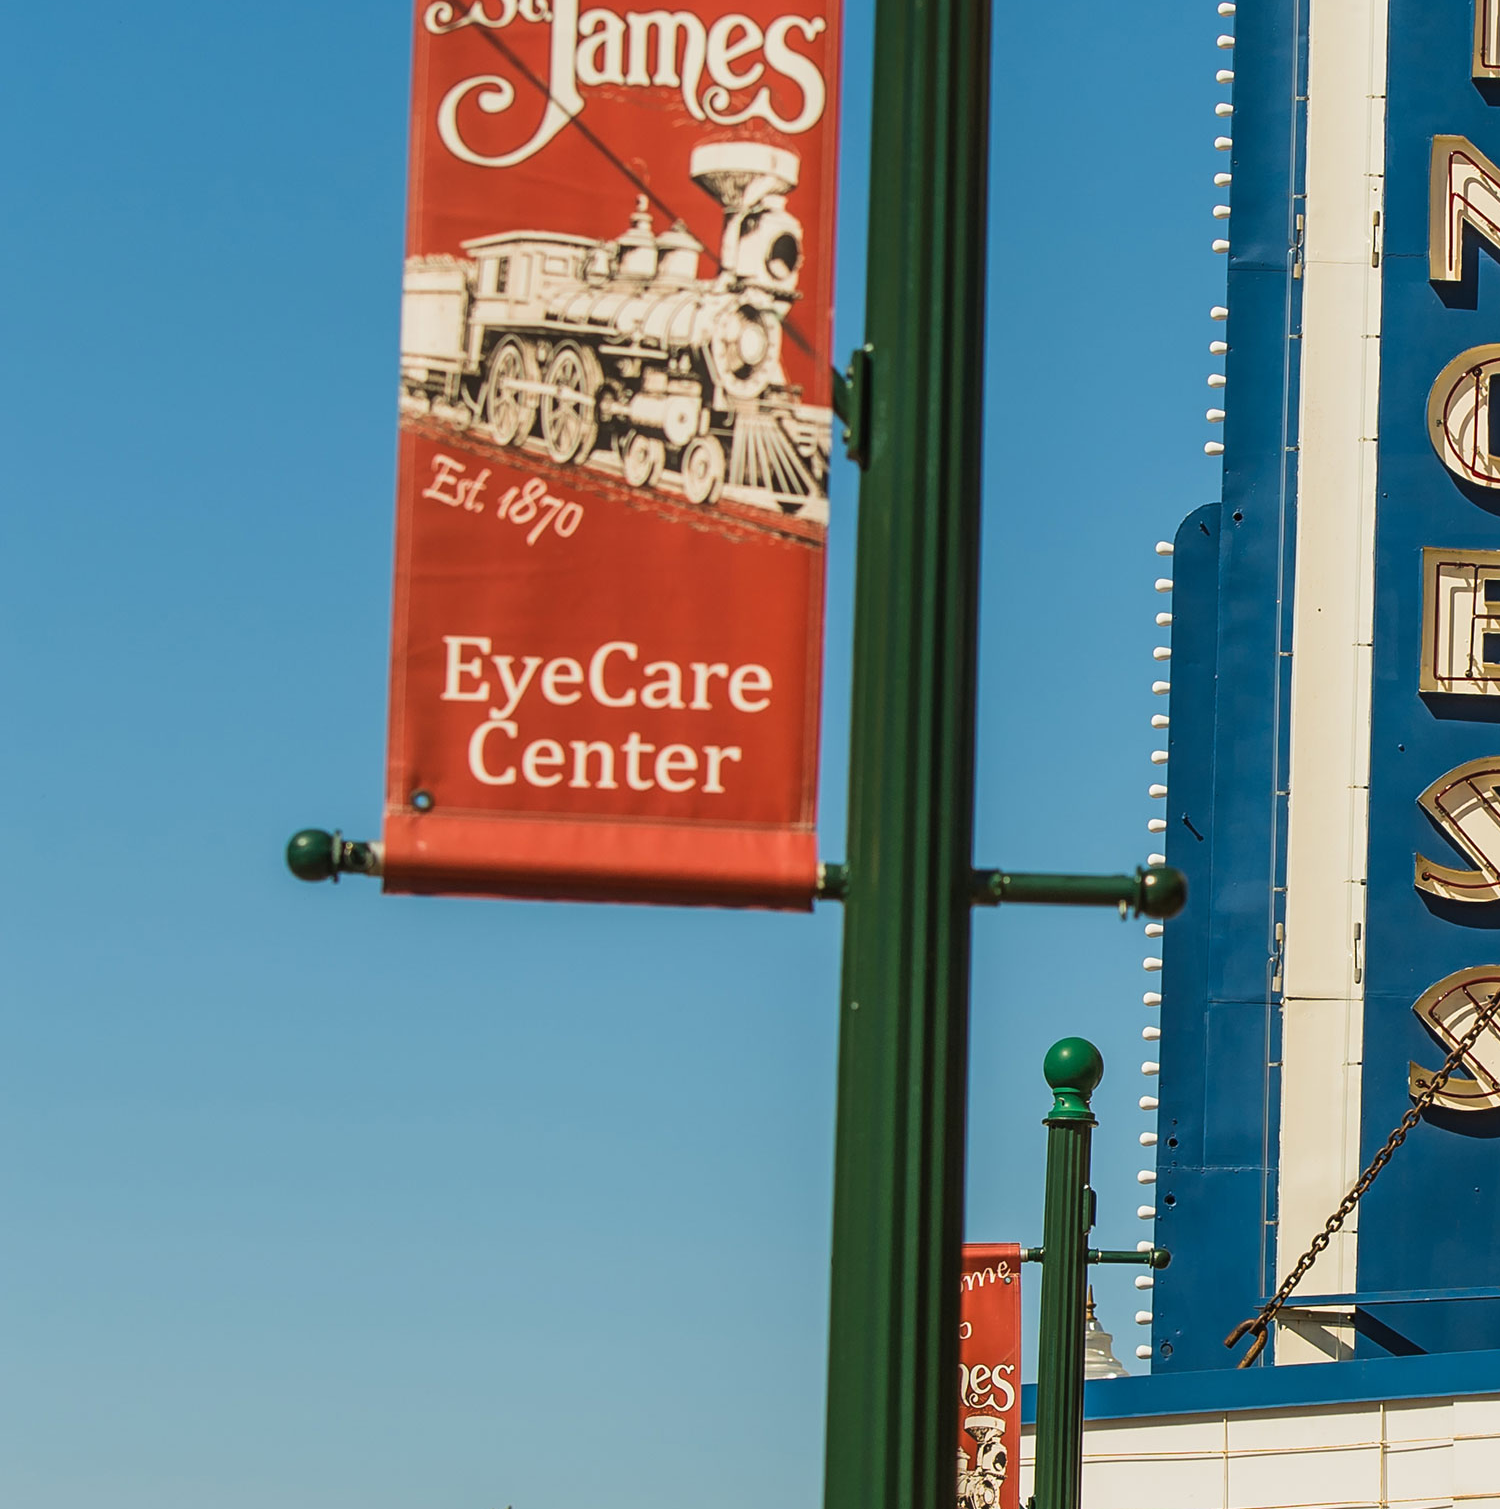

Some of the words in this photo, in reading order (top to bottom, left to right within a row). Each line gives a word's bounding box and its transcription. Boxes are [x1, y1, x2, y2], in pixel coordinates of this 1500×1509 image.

[422, 453, 491, 512] Est.
[496, 476, 584, 546] 1870
[439, 635, 774, 721] EyeCare
[468, 720, 742, 794] Center
